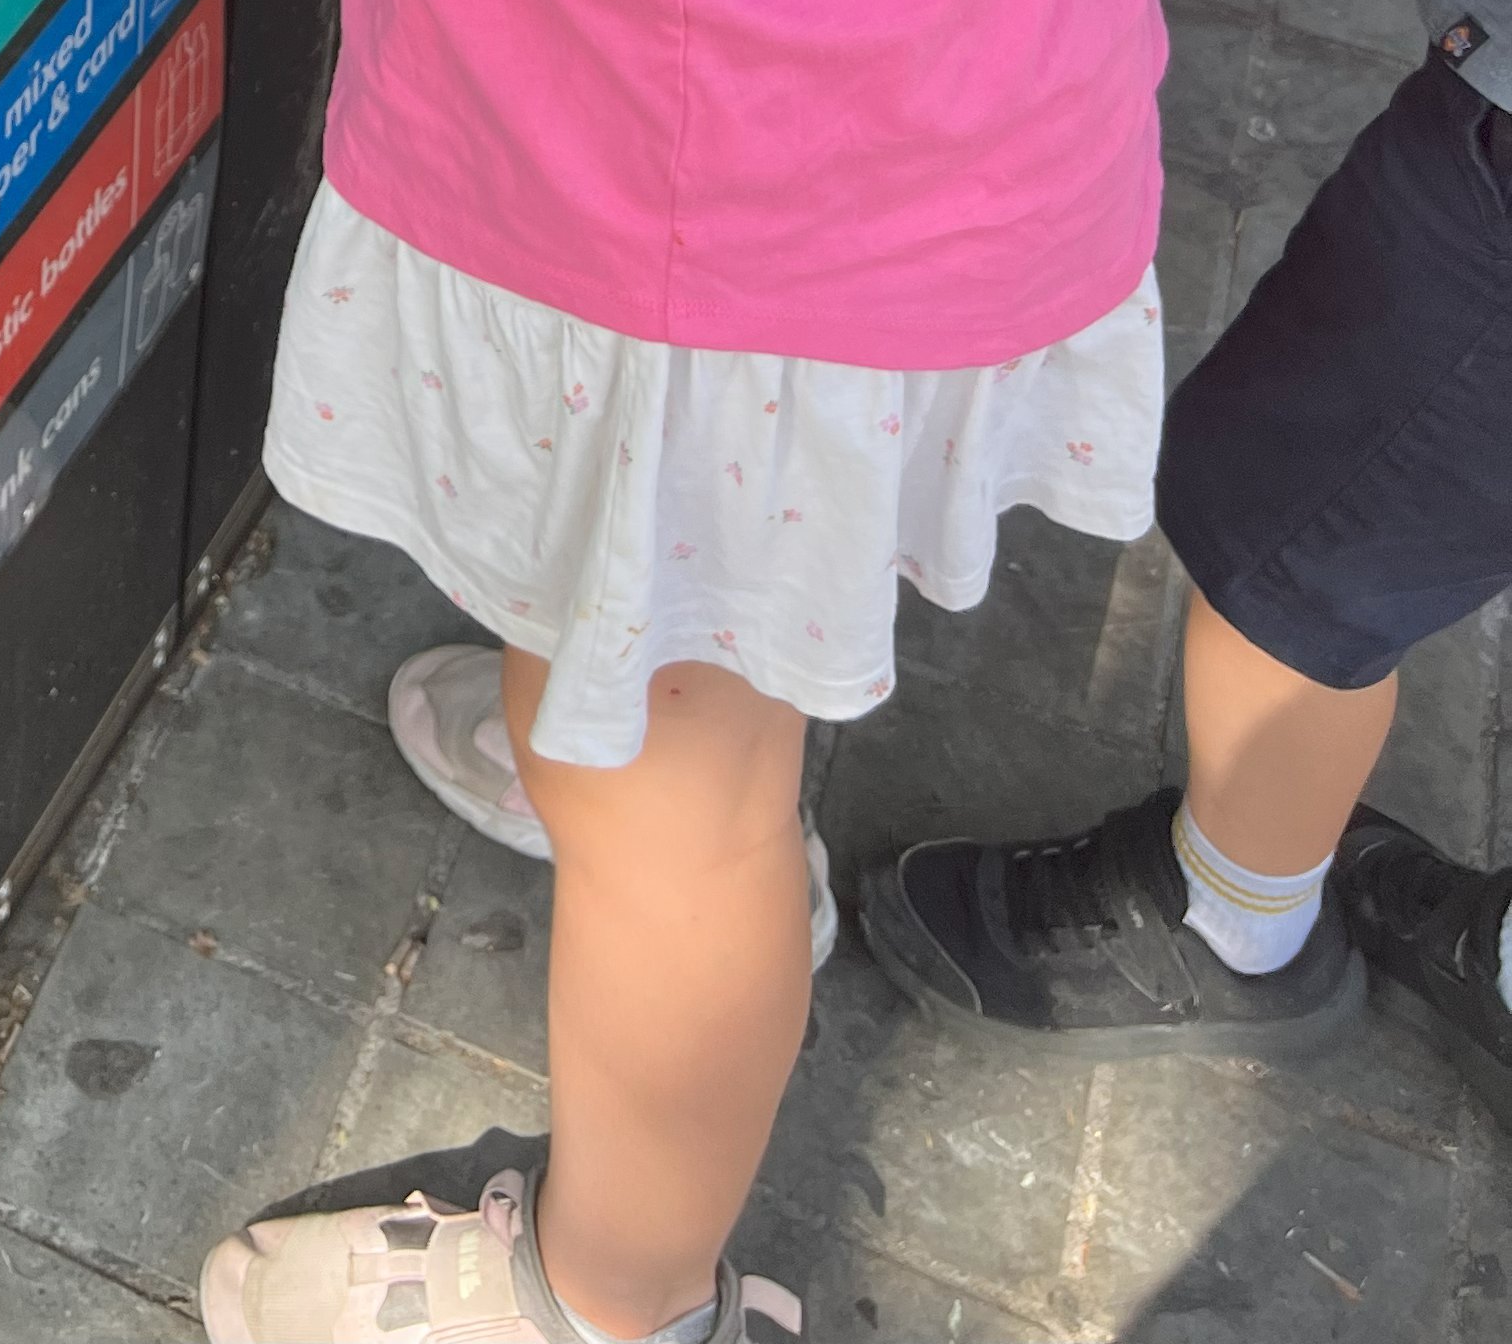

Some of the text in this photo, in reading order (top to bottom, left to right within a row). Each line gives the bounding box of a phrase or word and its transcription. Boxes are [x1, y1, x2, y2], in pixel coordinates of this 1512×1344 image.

[46, 81, 71, 132] &
[40, 166, 129, 299] bottles
[41, 355, 103, 450] cans
